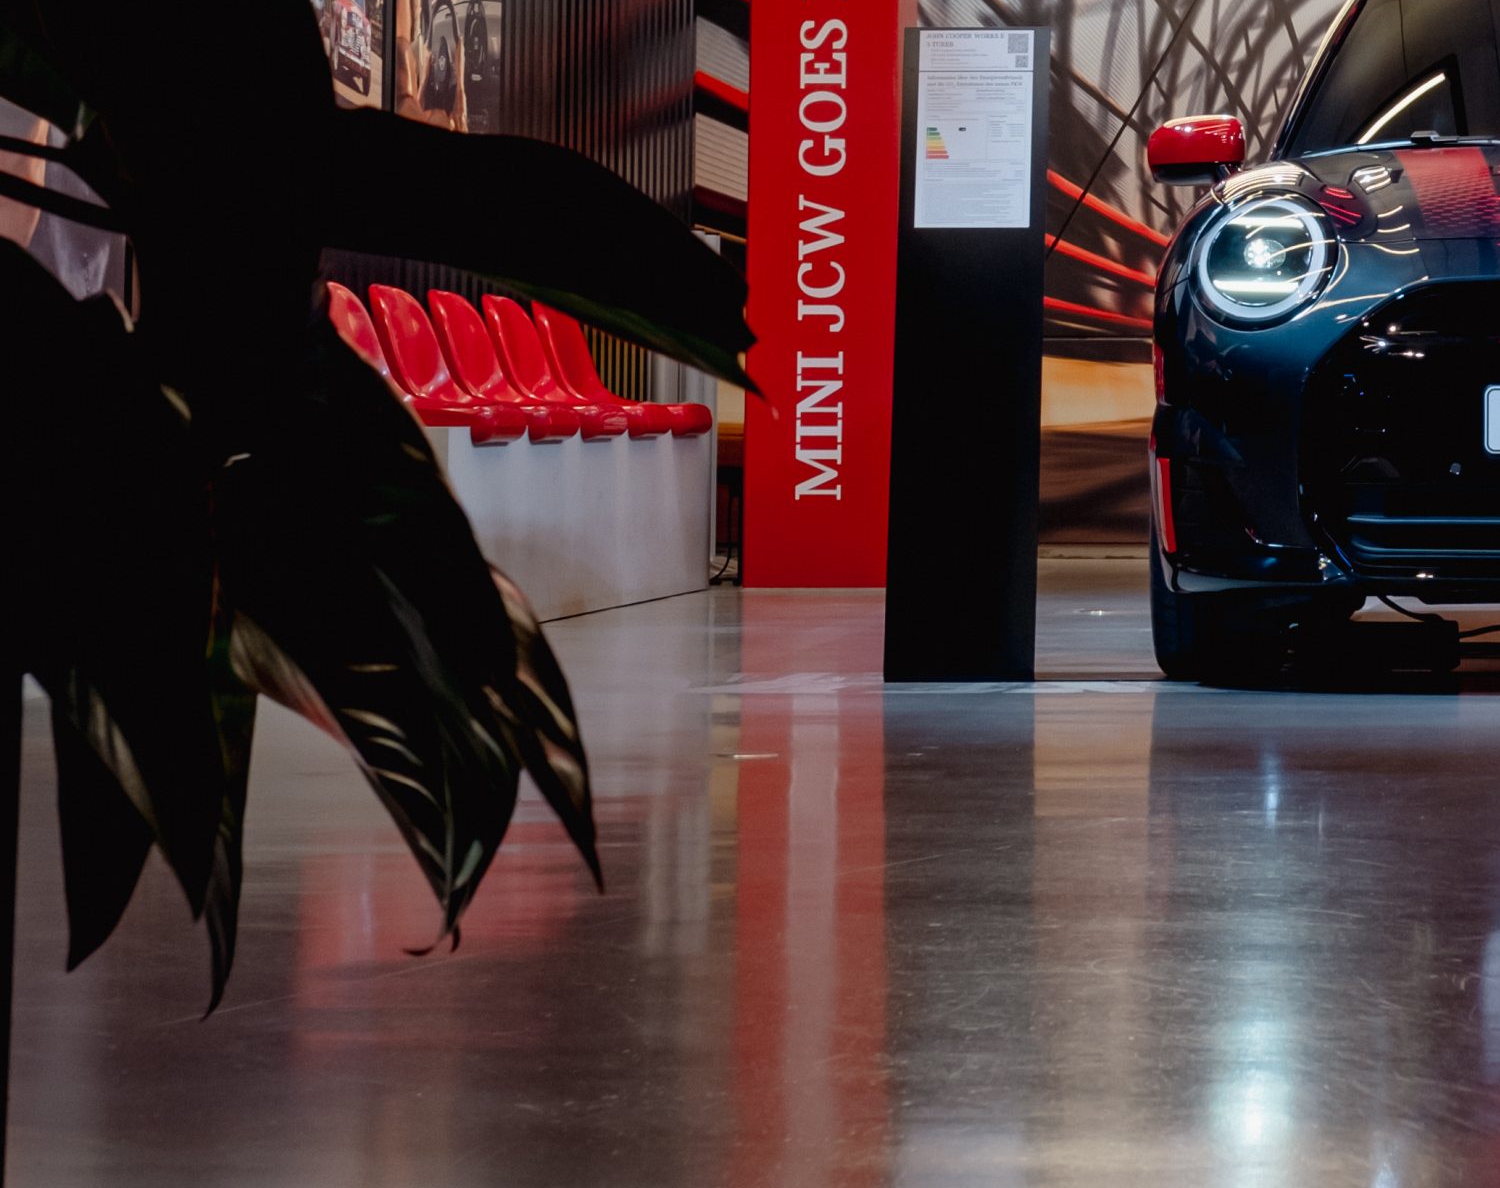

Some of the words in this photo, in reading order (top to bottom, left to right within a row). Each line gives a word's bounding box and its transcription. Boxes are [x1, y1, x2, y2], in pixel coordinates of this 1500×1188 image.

[798, 18, 848, 177] GOES
[796, 194, 846, 332] JCW
[794, 350, 844, 501] MINI
